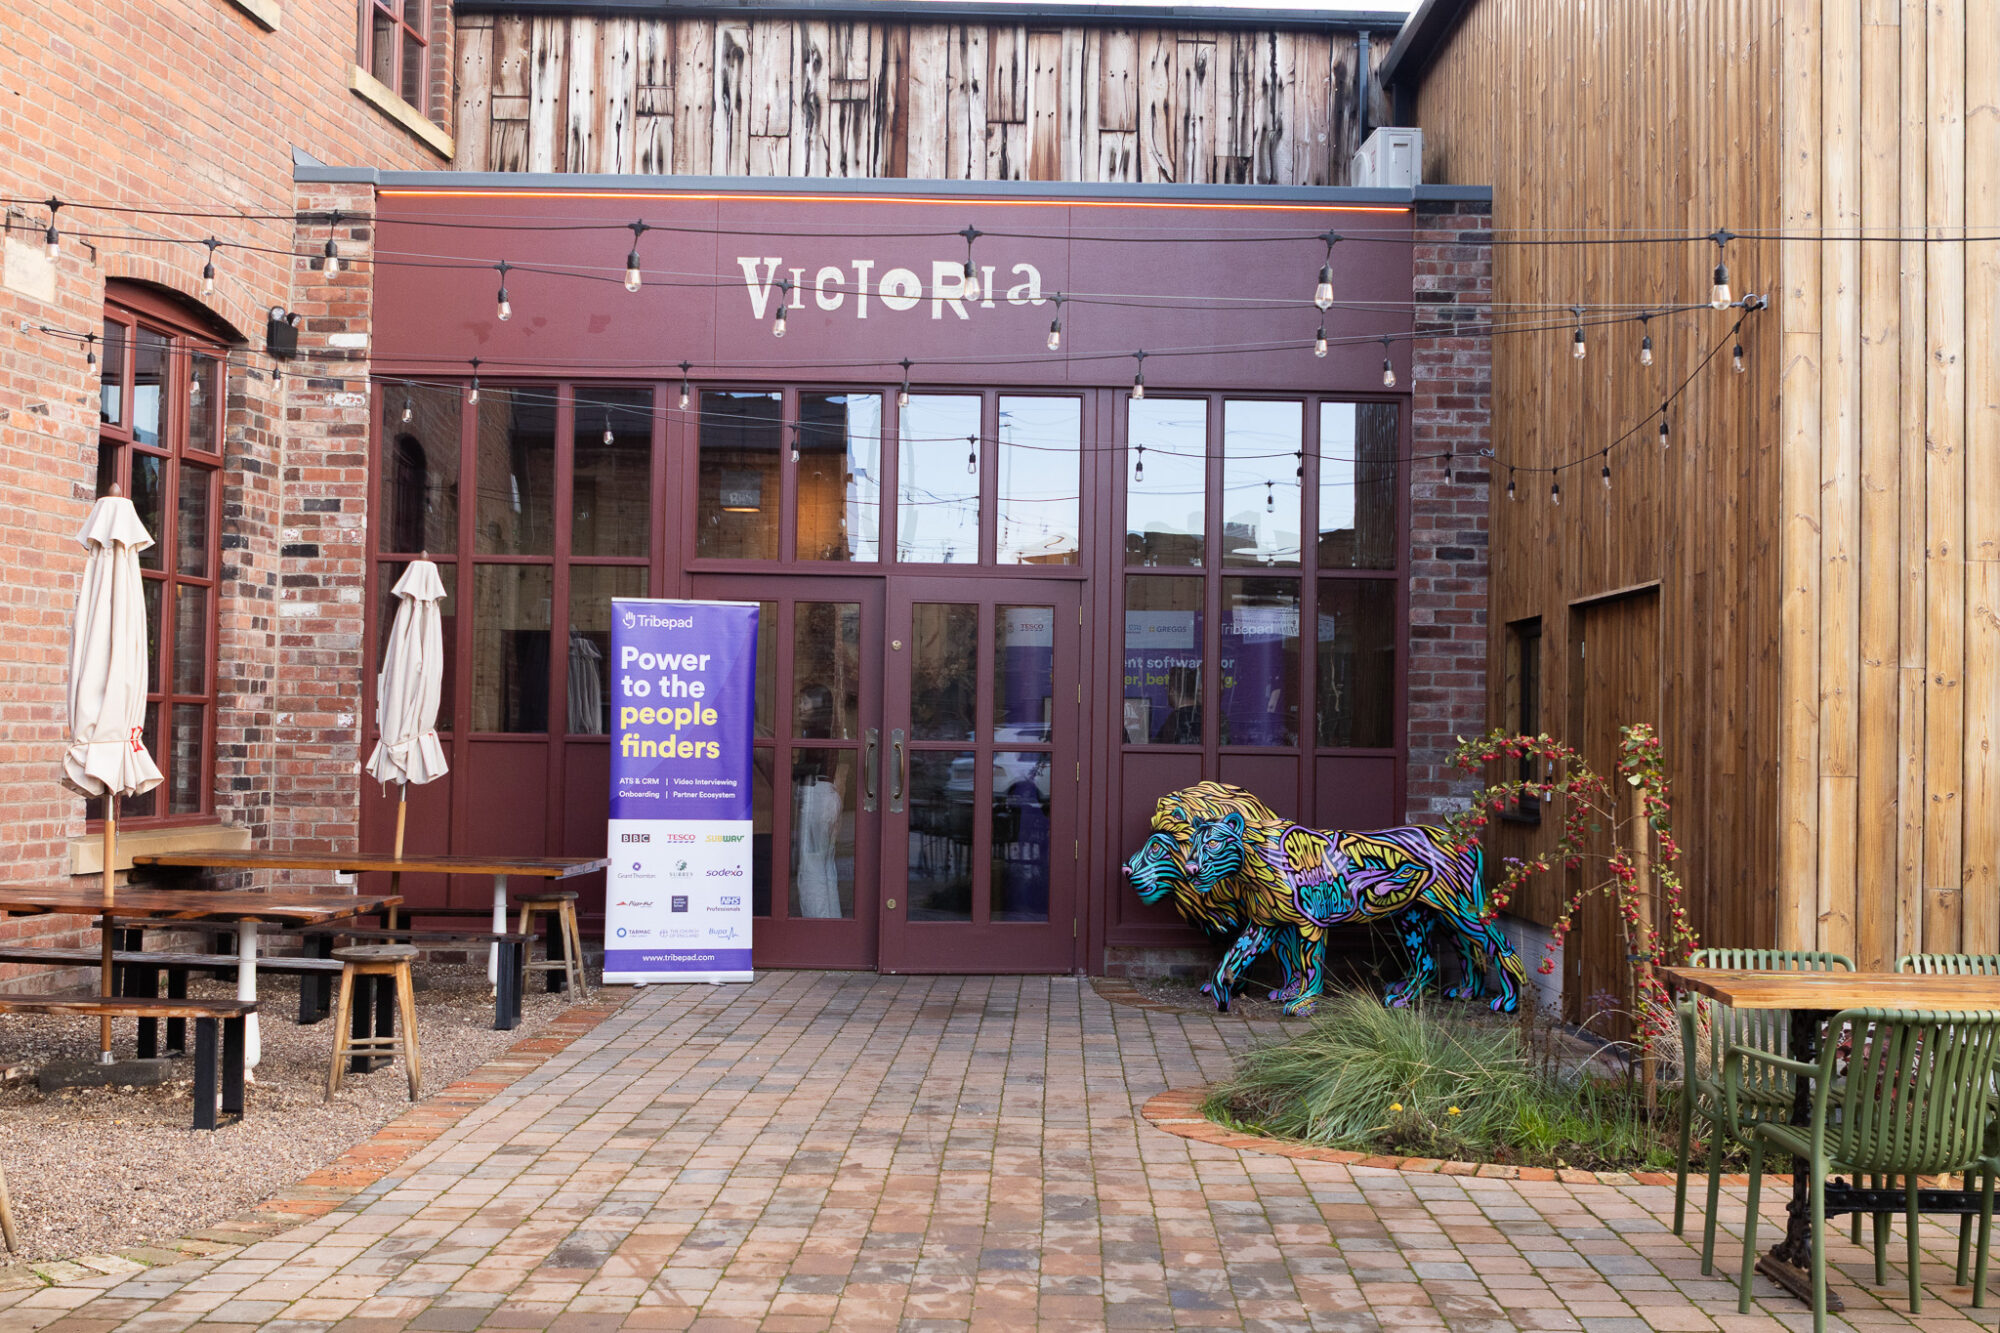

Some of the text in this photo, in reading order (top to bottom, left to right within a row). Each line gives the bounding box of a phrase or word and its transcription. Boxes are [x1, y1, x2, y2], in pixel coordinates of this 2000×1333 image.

[637, 615, 693, 631] Tribepad
[1157, 625, 1188, 633] GREGGS
[1221, 622, 1274, 637] Tribepad
[620, 645, 711, 672] Power
[1147, 656, 1203, 669] softwar
[620, 674, 705, 699] to the
[620, 701, 718, 731] people
[620, 732, 721, 759] finders
[619, 777, 634, 785] ATS
[641, 777, 660, 785] CRM
[695, 778, 738, 787] Interviewing
[618, 790, 660, 799] Onboarding
[699, 791, 736, 800] Ecosystem
[622, 833, 650, 843] BBC
[667, 833, 696, 841] TESCO
[705, 834, 745, 843] SUBWAY
[706, 865, 743, 877] sodexo
[642, 953, 715, 962] www.tribepad.com
